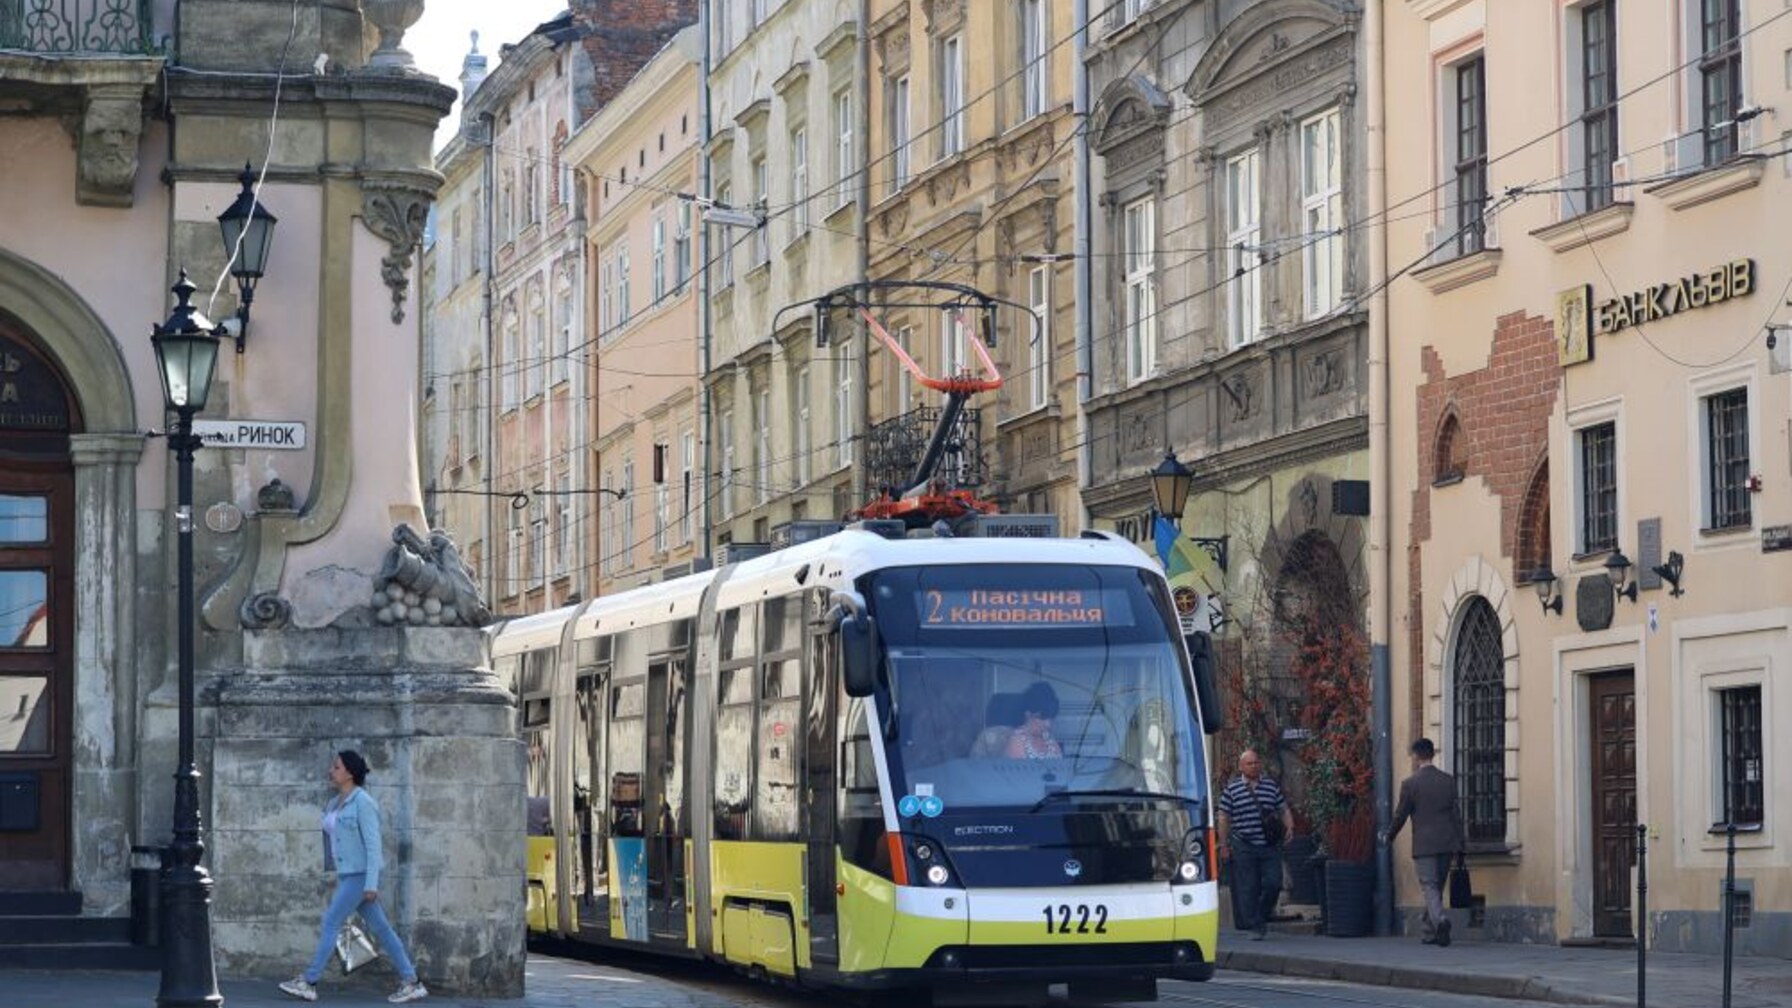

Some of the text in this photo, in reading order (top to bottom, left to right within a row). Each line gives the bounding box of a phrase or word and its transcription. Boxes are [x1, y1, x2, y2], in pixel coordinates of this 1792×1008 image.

[1599, 257, 1754, 332] БАНК ЛЬВІВ
[237, 425, 296, 445] РИНОК
[926, 589, 944, 624] 2
[971, 589, 1082, 605] Пасічна
[950, 608, 1103, 624] Коновальця
[1042, 904, 1109, 934] 1222
